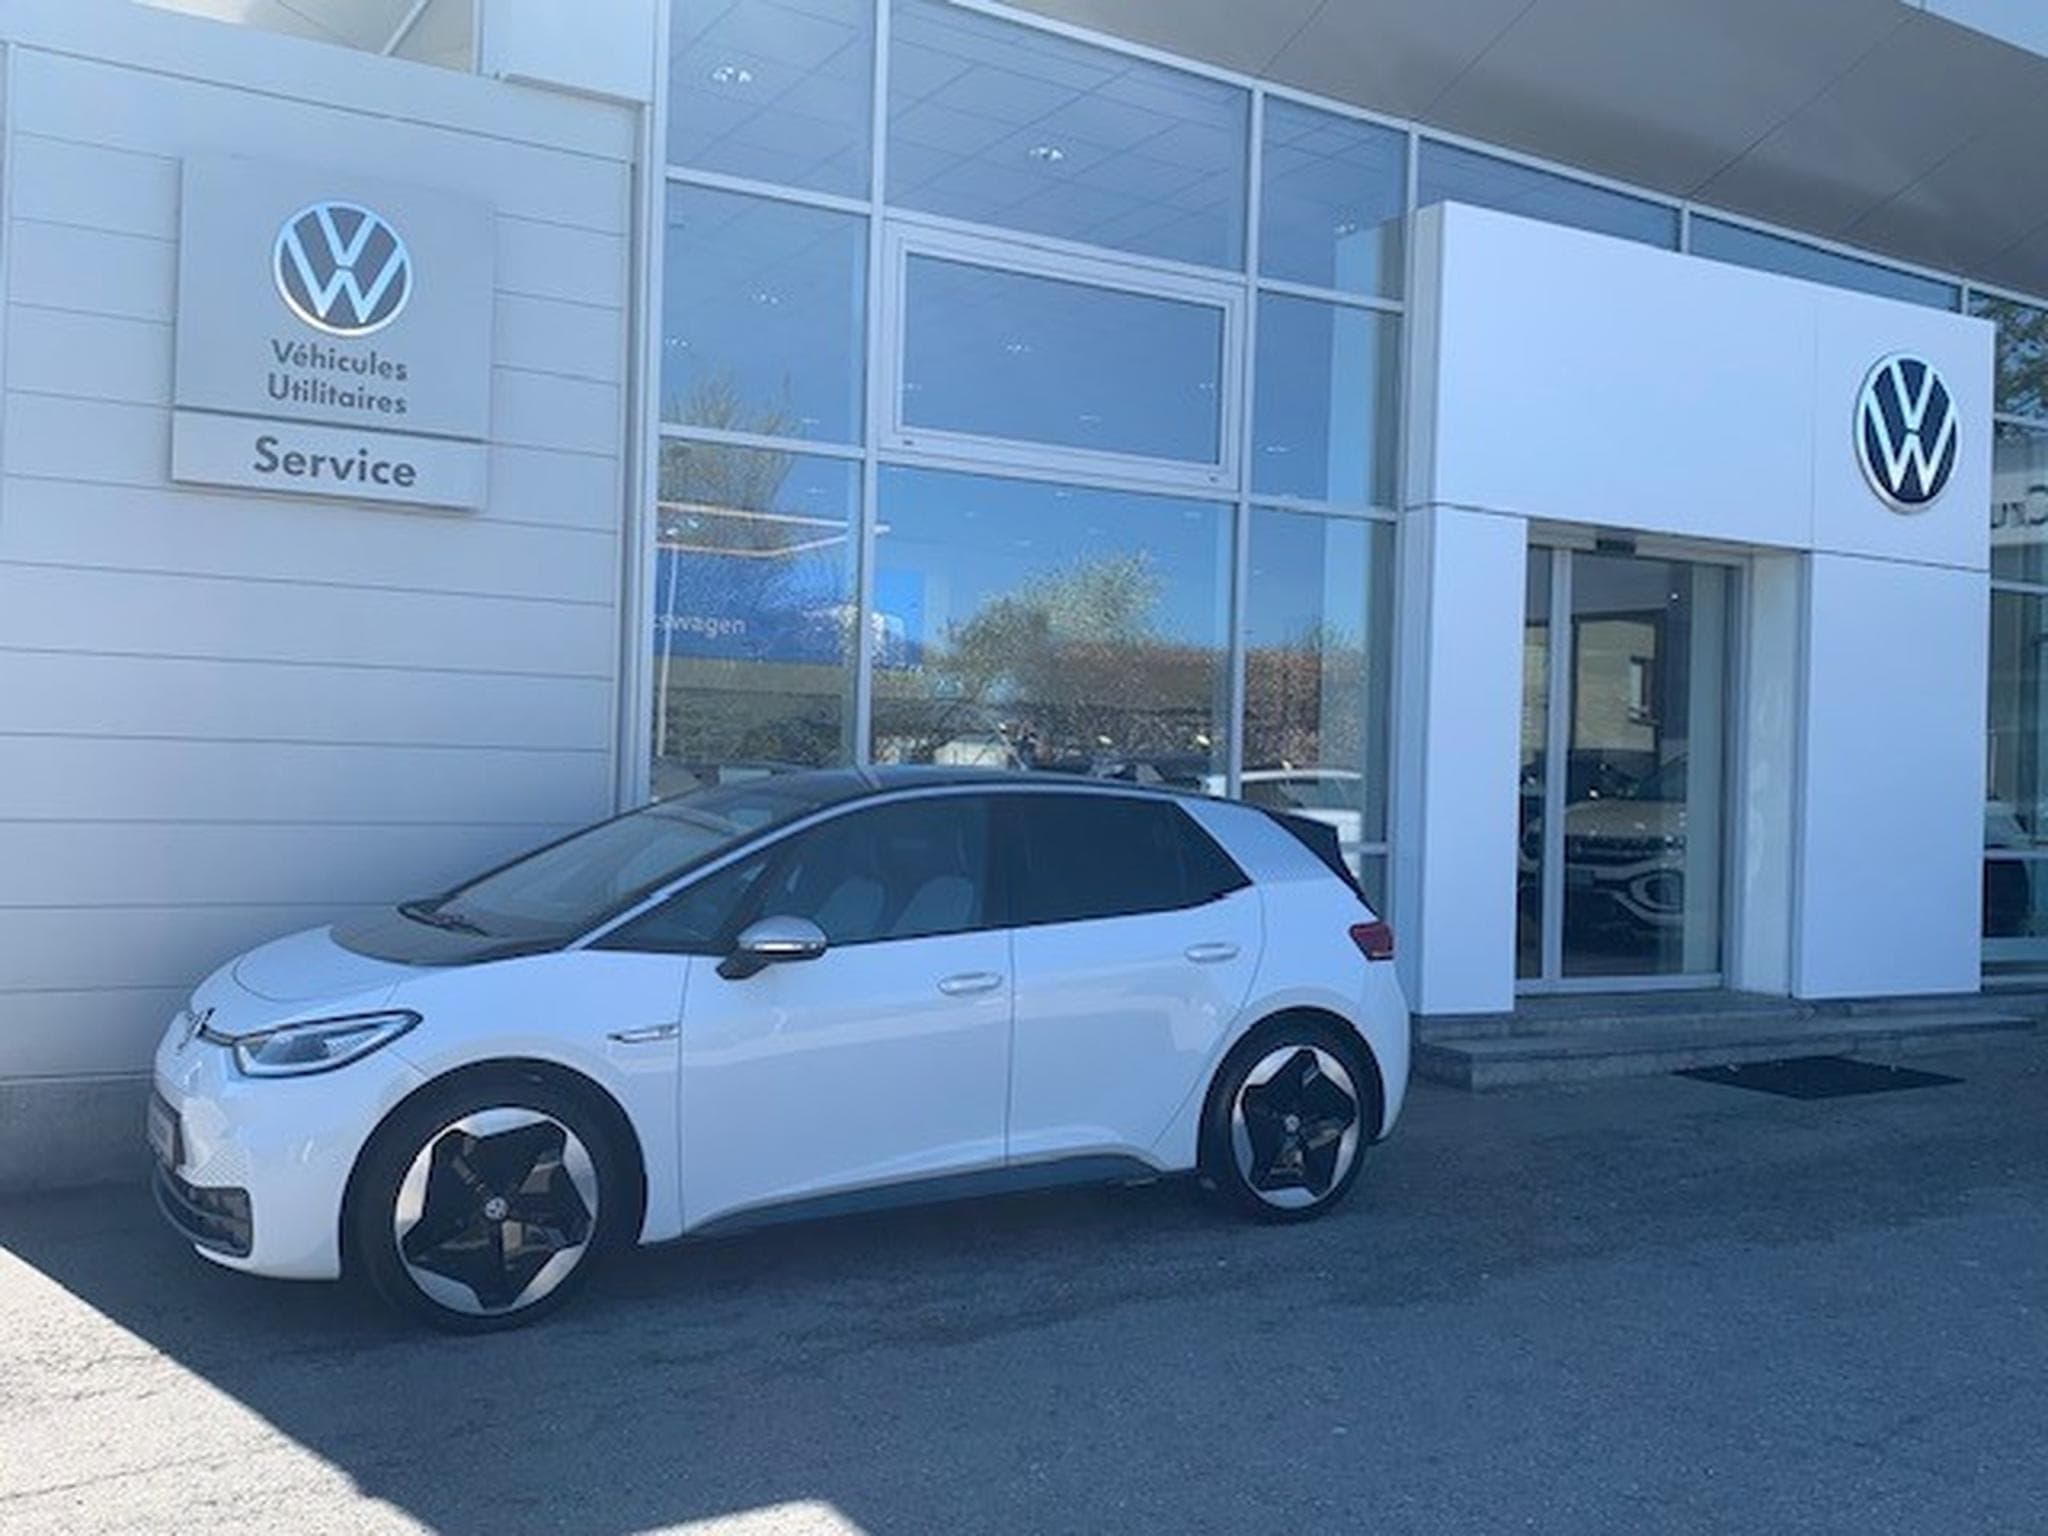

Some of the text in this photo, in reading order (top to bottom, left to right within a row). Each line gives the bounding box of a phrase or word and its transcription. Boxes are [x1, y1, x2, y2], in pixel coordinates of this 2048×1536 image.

[271, 339, 408, 382] Véhicules
[268, 373, 407, 414] Utilitaires
[253, 435, 417, 488] Service
